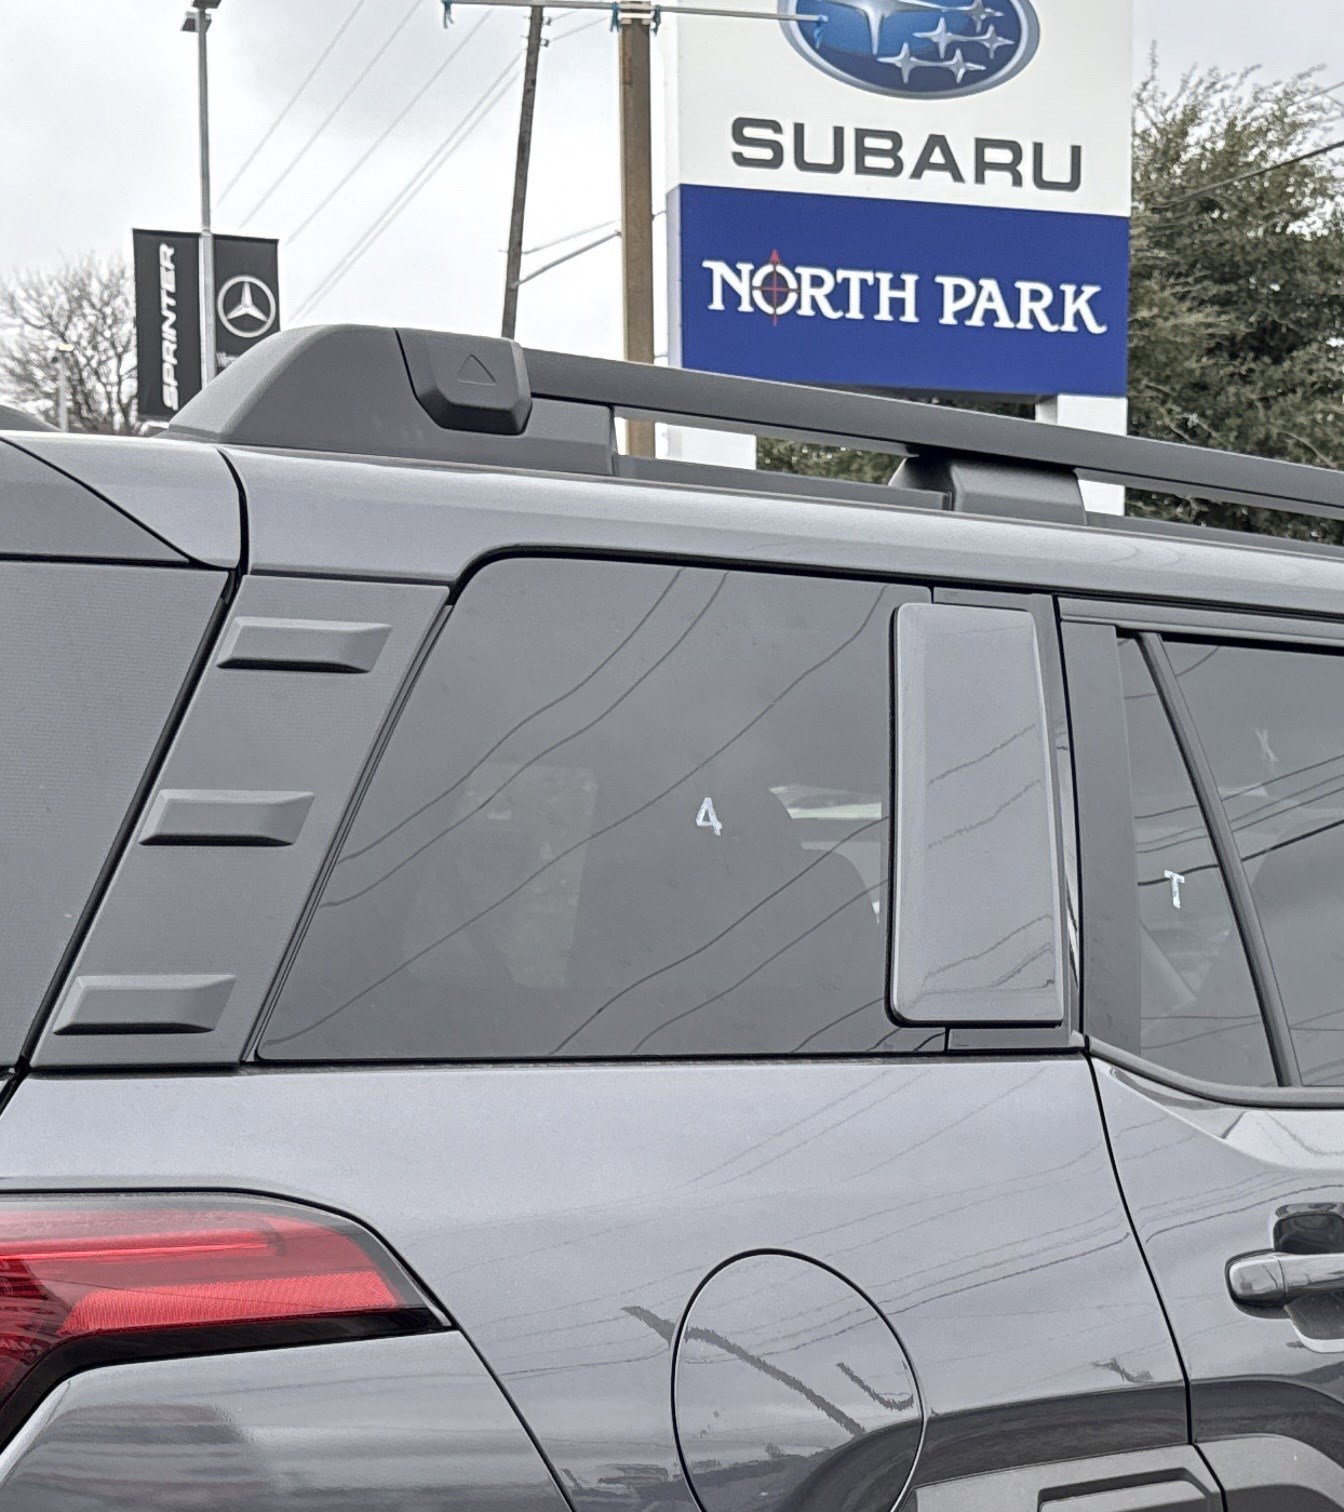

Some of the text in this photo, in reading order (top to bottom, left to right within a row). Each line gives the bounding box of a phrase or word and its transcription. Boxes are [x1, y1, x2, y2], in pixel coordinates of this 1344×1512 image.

[731, 116, 1083, 193] SUBARU
[159, 243, 179, 411] SPRINTER
[701, 256, 1108, 336] NORTH PARK
